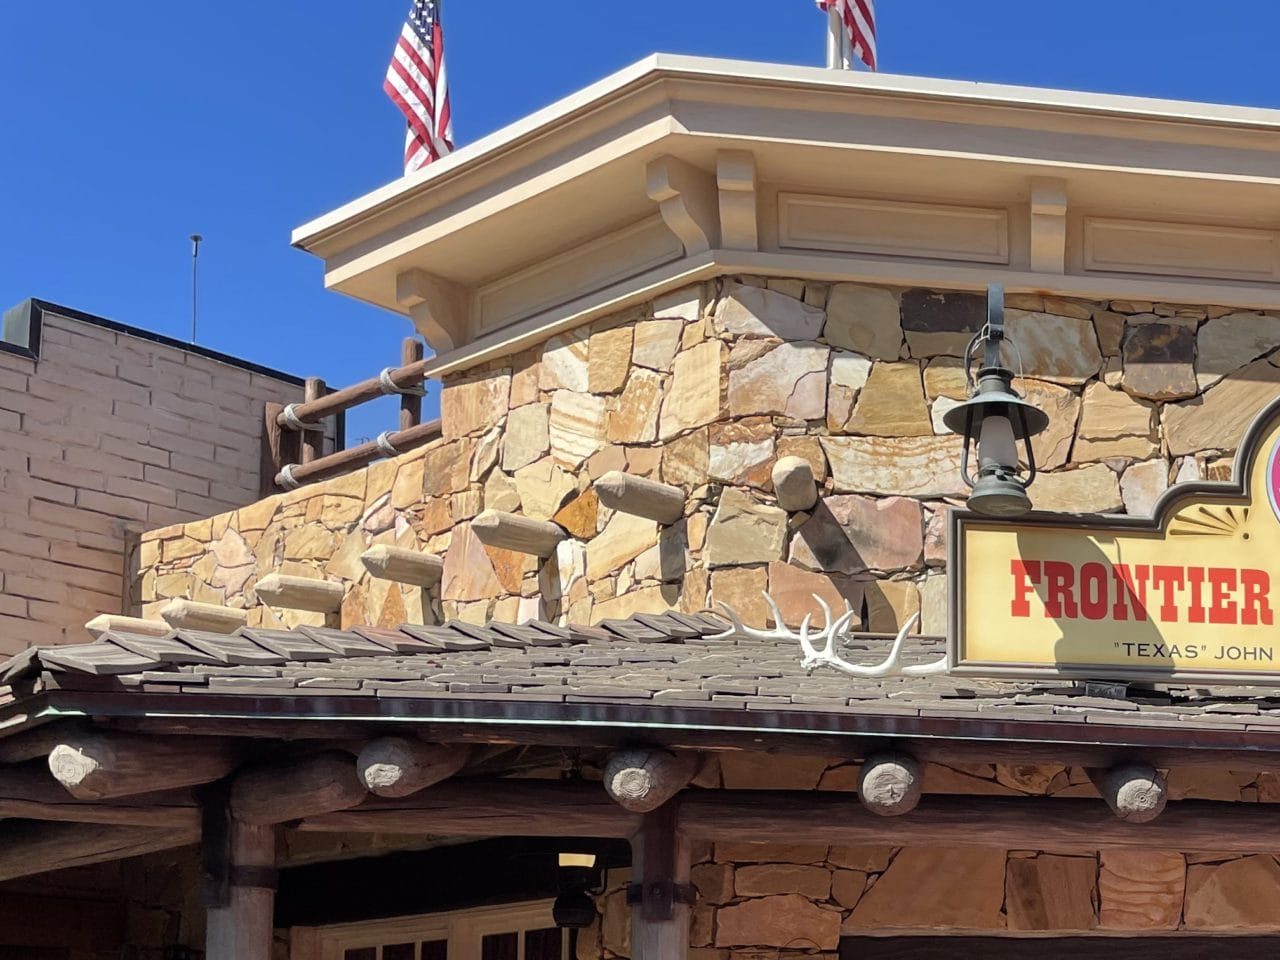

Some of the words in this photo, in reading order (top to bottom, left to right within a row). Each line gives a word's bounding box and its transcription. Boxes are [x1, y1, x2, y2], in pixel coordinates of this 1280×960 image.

[1010, 559, 1274, 626] FRONTIER
[1113, 641, 1208, 659] "TEXAS"
[1213, 645, 1274, 662] JOHN
